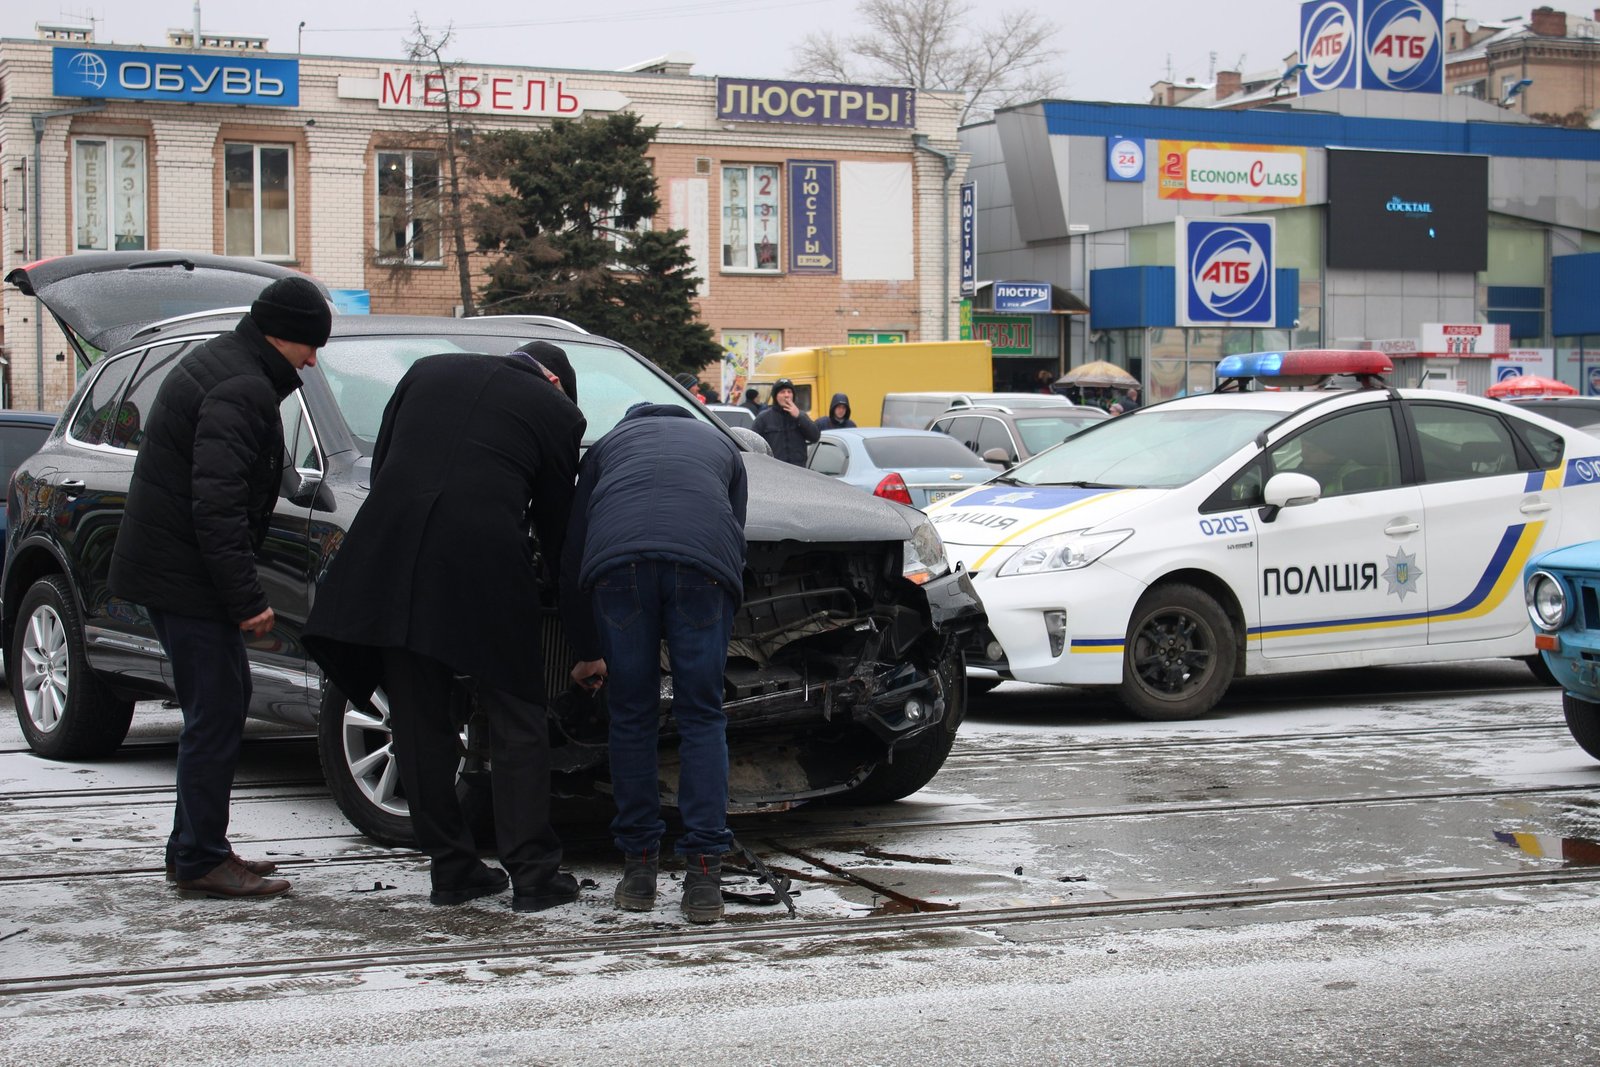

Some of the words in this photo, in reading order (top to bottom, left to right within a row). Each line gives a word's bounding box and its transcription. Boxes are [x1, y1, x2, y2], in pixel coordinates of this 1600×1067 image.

[1311, 32, 1344, 57] АТБ
[1374, 34, 1427, 59] АТБ
[119, 62, 284, 97] ОБУВЬ
[382, 72, 579, 113] МЕБЕЛЬ
[722, 84, 899, 122] ЛЮСТРЫ
[1119, 155, 1136, 164] 24
[1166, 153, 1182, 177] 2
[84, 147, 98, 245] МЕБЕЛЬ
[759, 175, 772, 195] 2
[803, 167, 820, 254] ЛЮСТРЫ
[1386, 202, 1432, 212] COCKTAIL
[963, 189, 973, 278] ЛЮСТРЫ
[1202, 261, 1251, 284] АТБ
[997, 287, 1048, 298] ЛЮСТРЫ
[1199, 515, 1249, 536] 0205
[1263, 563, 1378, 596] ПОЛІЦІЯ
